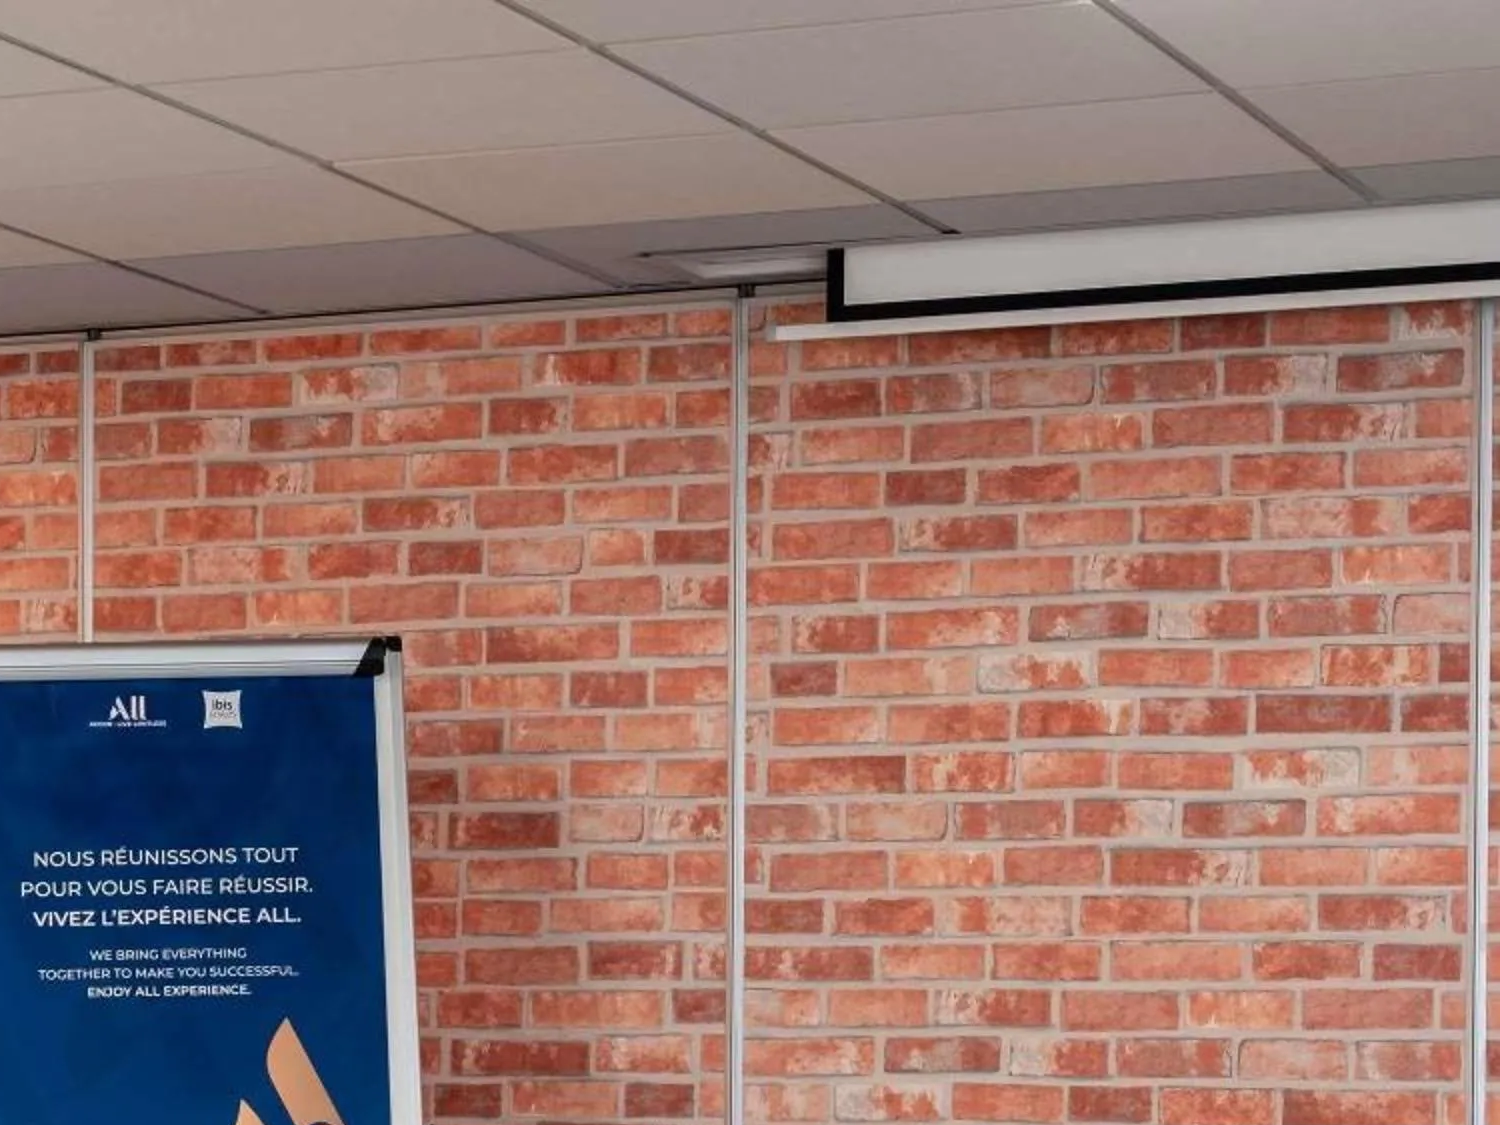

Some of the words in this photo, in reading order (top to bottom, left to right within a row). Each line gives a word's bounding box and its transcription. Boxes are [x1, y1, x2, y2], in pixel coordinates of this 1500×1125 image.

[33, 851, 95, 867] NOUS
[101, 846, 237, 866] RÉUNISSONS
[242, 847, 299, 864] TOUT
[21, 881, 81, 897] POUR
[87, 880, 147, 896] VOUS
[153, 878, 213, 895] FAIRE
[219, 874, 313, 894] RÉUSSIR.
[33, 911, 96, 927] VIVEZ
[257, 907, 302, 923] ALL.
[90, 950, 113, 961] WE
[116, 949, 159, 960] BRING
[162, 947, 247, 960] EVERYTHING
[38, 968, 111, 981] TOGETHER
[114, 968, 133, 979] TO
[136, 968, 174, 979] MAKE
[178, 967, 207, 978] YOU
[209, 965, 299, 978] SUCCESSFUL.
[88, 986, 132, 998] ENJOY
[135, 985, 161, 997] ALL
[164, 983, 252, 997] EXPERIENCE.
